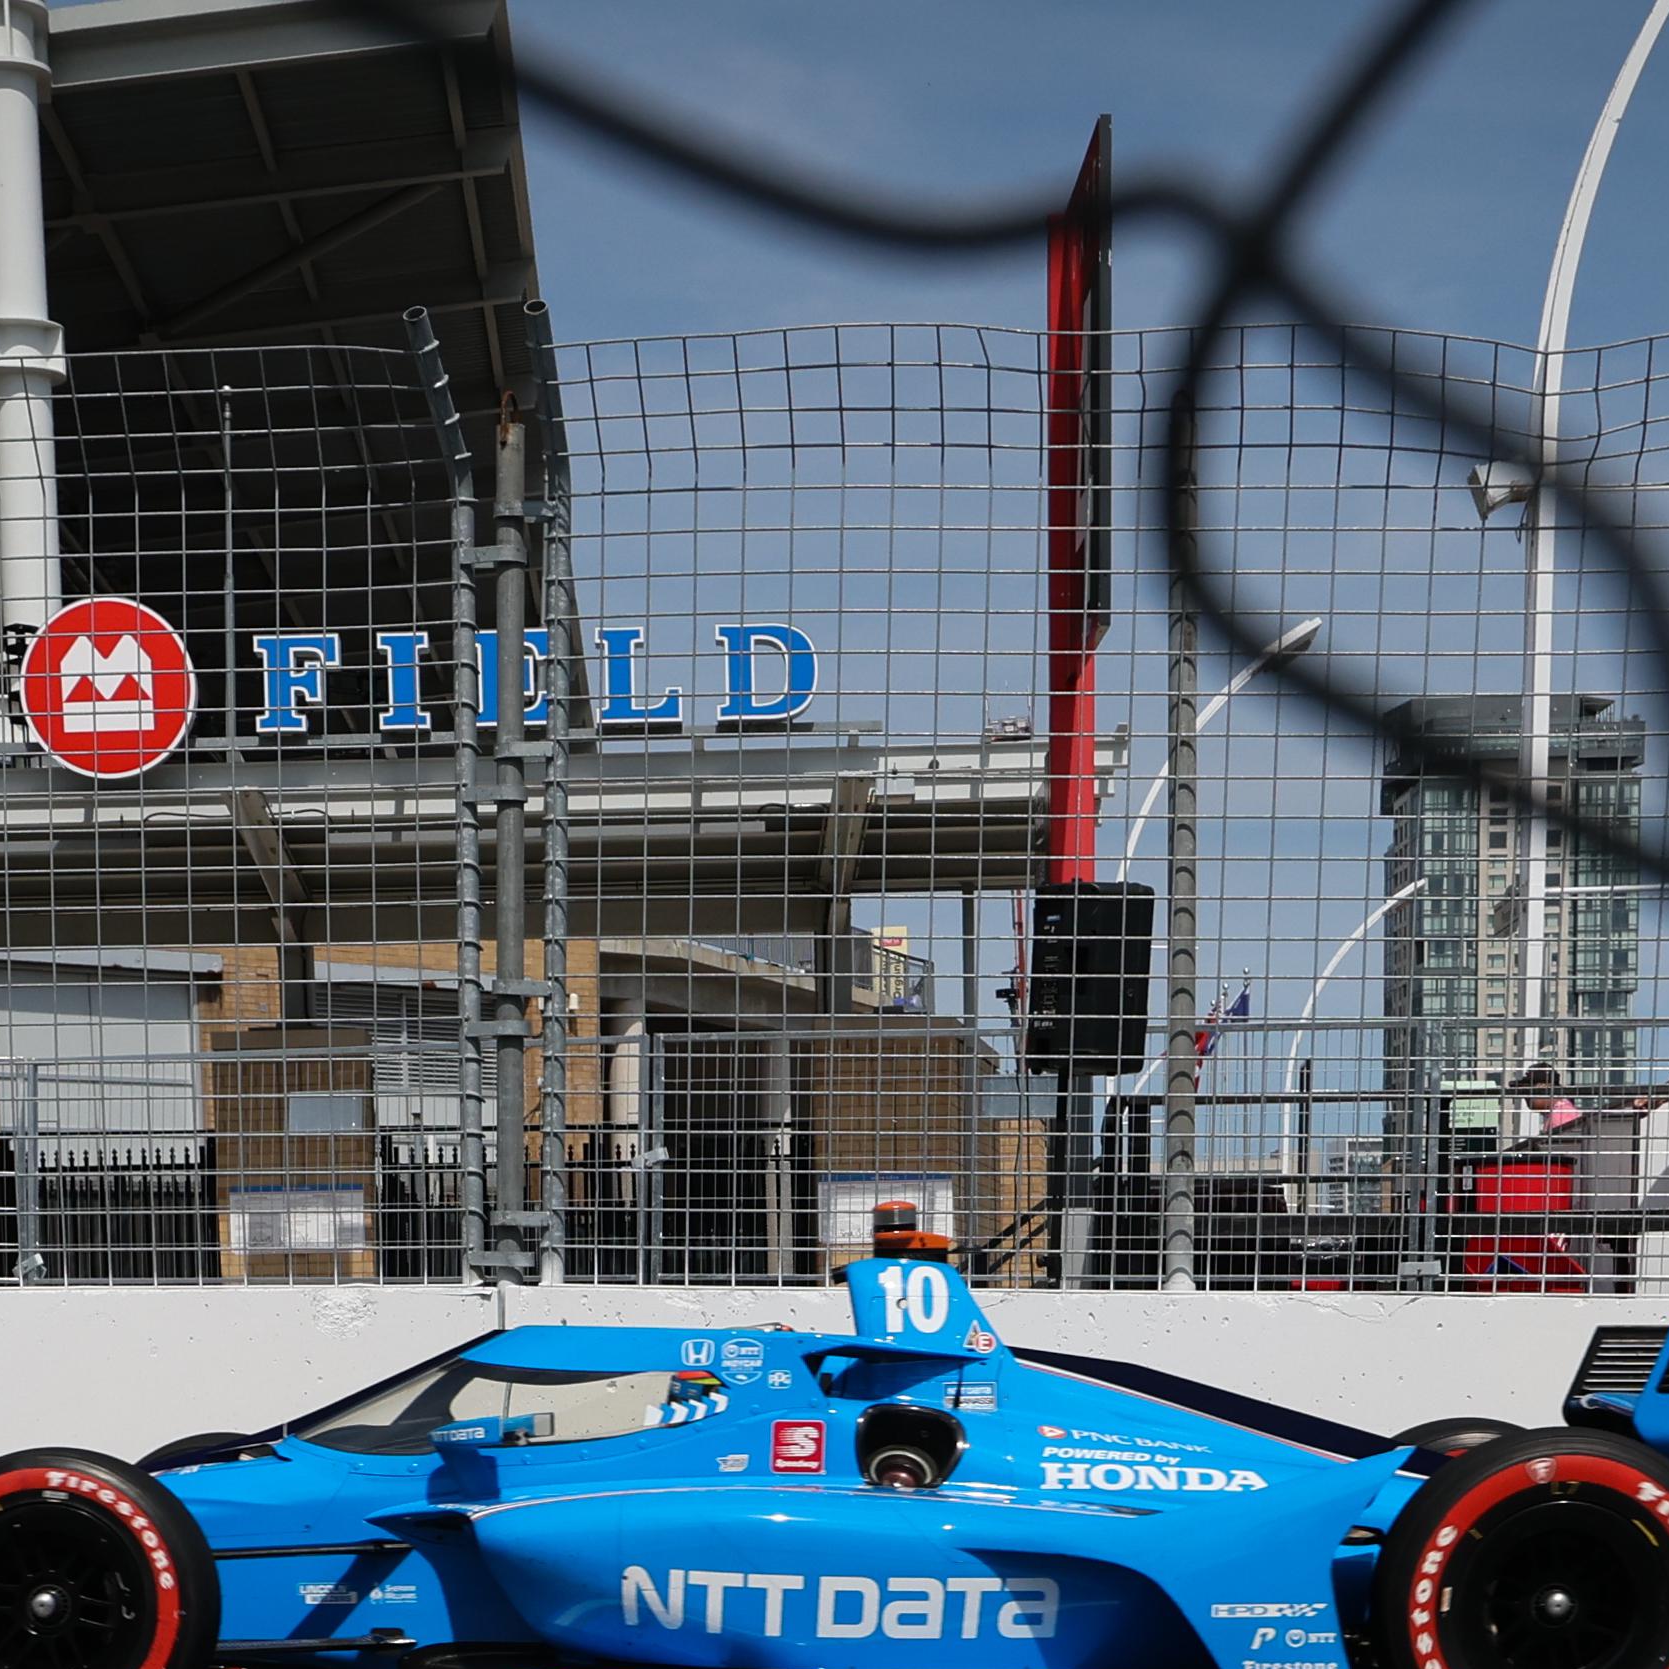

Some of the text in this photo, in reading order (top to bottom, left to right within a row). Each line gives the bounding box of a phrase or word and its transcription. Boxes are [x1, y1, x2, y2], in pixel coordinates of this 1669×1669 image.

[253, 623, 819, 733] FIELD
[878, 1266, 949, 1333] 10
[1043, 1447, 1181, 1465] POWERED by
[1071, 1430, 1213, 1454] PNC BANK
[1040, 1462, 1268, 1491] HONDA
[45, 1470, 174, 1590] Firestone
[622, 1566, 805, 1637] NTT
[1214, 1606, 1269, 1616] HPD
